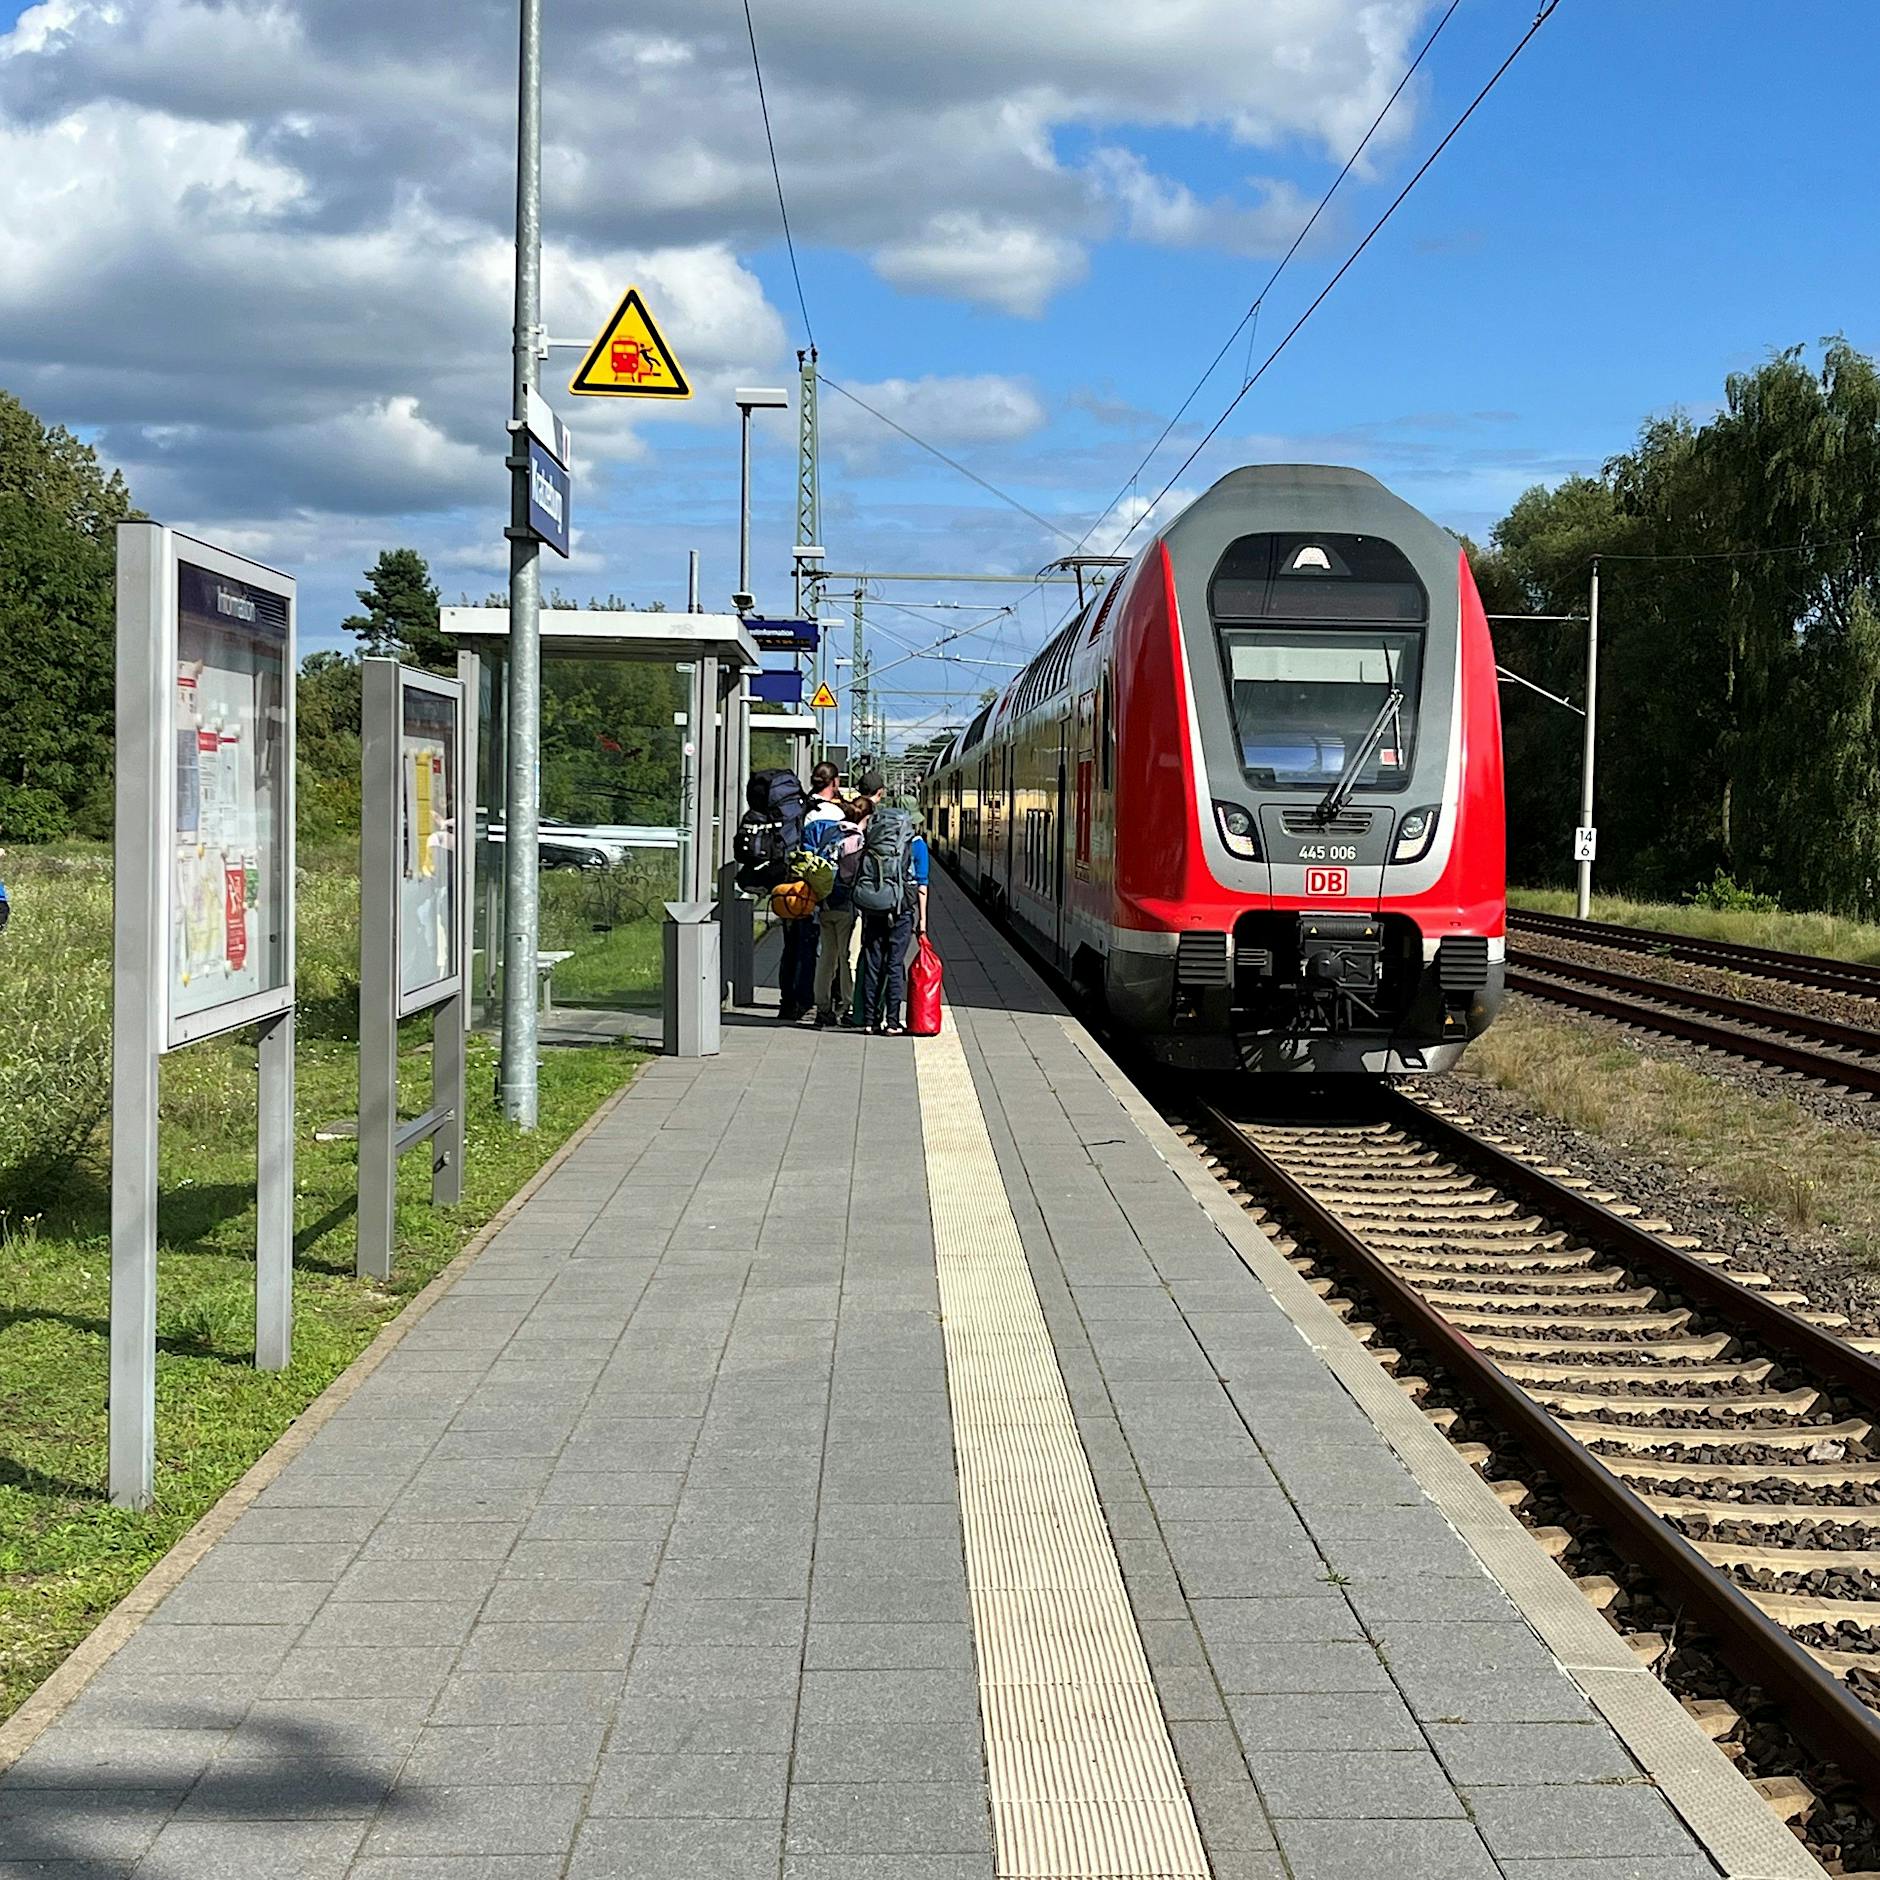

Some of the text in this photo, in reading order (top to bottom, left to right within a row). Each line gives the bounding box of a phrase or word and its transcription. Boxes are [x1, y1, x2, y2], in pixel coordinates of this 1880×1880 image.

[1580, 830, 1592, 842] 14
[1298, 845, 1357, 860] 445 006
[1581, 844, 1590, 856] 6
[1310, 872, 1342, 892] DB
